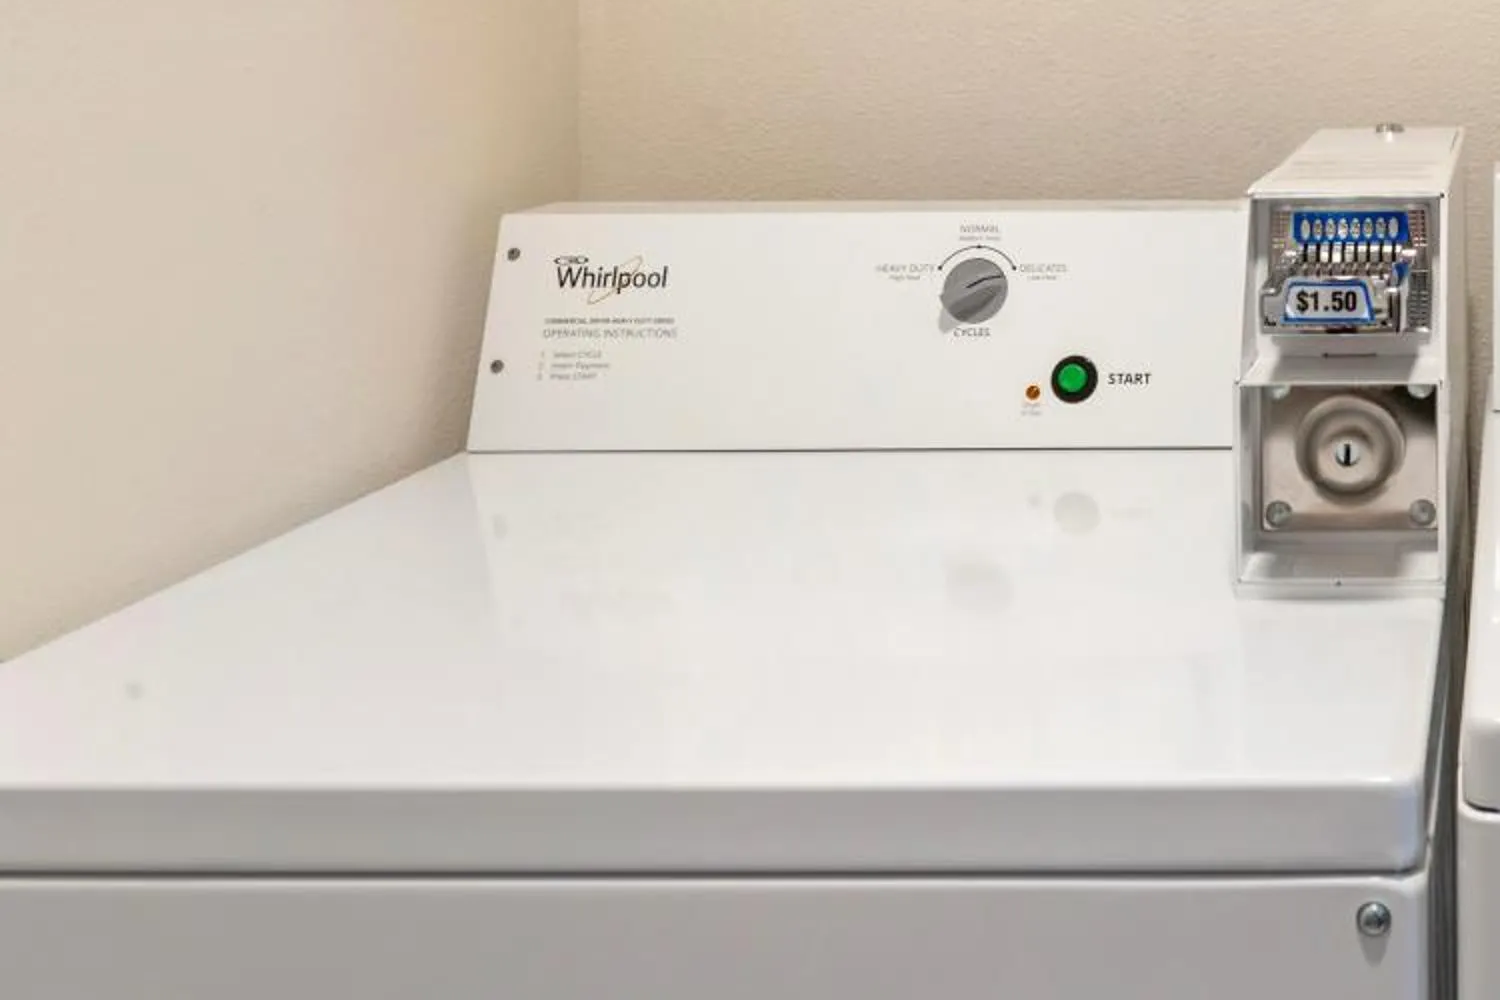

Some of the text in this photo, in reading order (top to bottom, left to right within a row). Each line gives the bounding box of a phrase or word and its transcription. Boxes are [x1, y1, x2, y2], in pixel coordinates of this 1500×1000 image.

[556, 266, 668, 294] Whirlpool
[1296, 290, 1357, 313] $1.50
[953, 327, 991, 337] CYCLES
[1107, 373, 1152, 385] START
